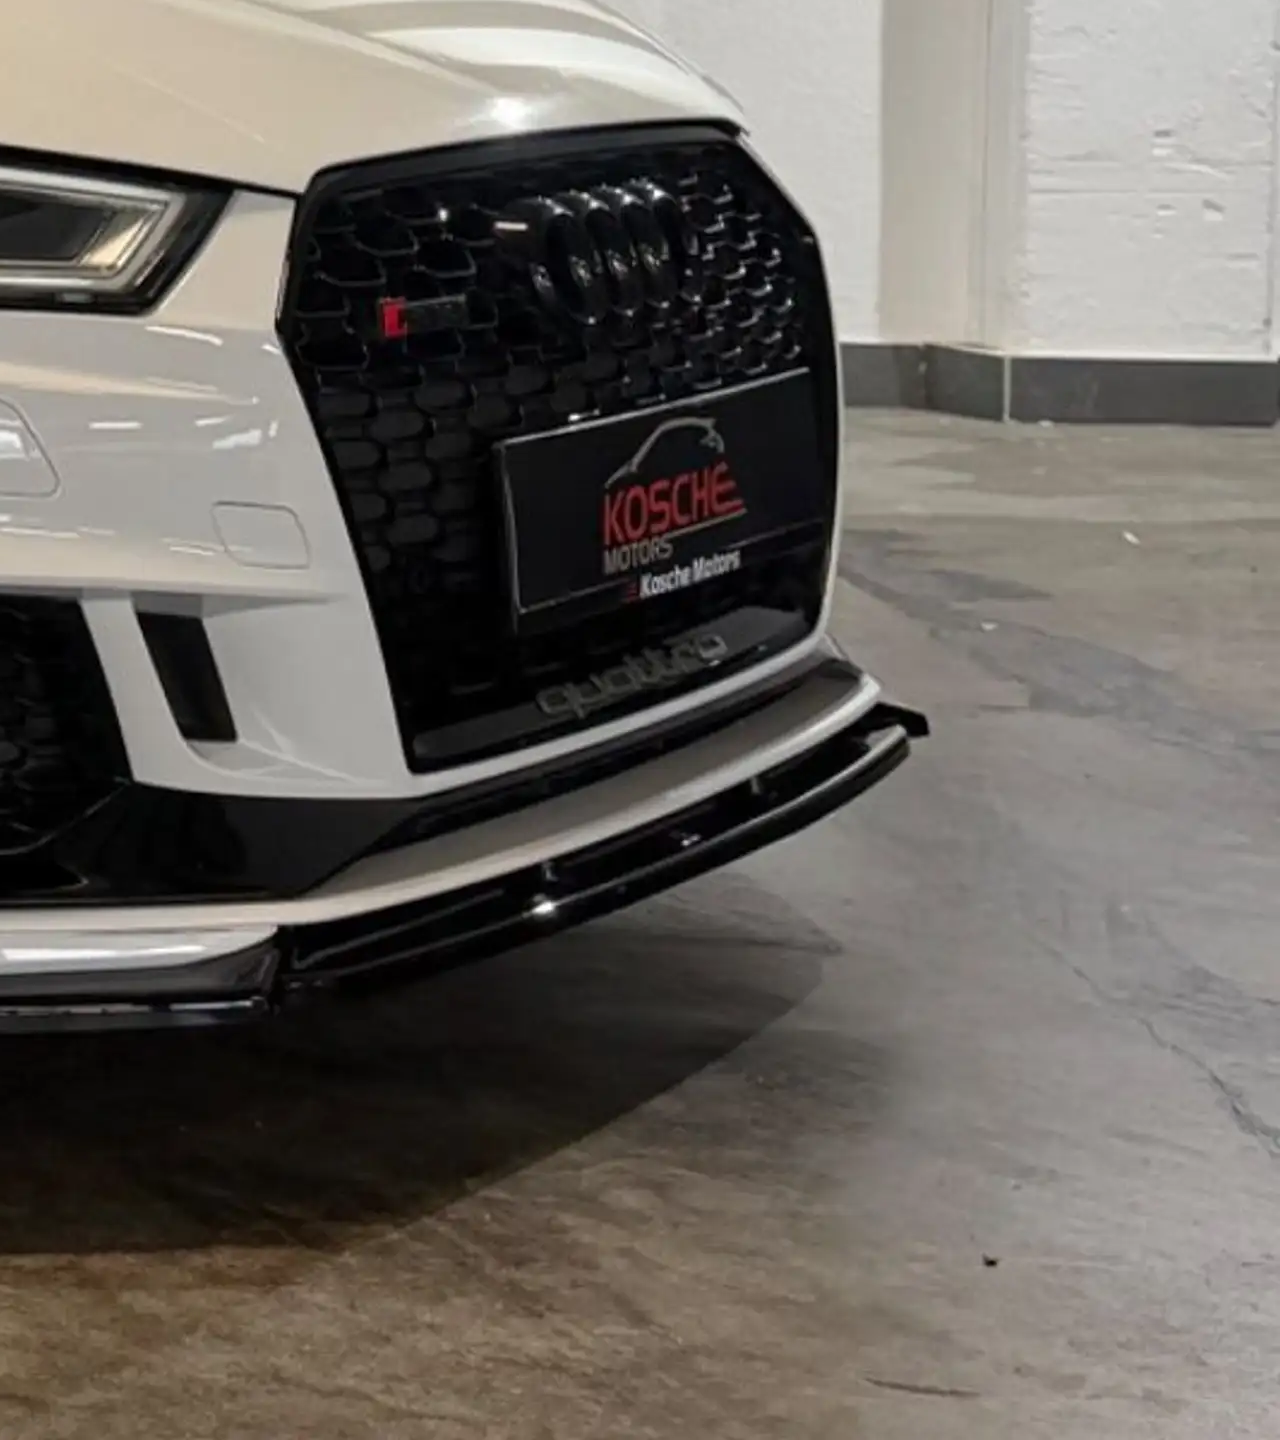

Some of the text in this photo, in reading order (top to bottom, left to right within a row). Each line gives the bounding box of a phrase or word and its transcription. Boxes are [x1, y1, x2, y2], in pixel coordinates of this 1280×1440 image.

[602, 460, 744, 546] KOSCHE
[603, 536, 674, 574] MOTORS
[640, 550, 741, 600] Kosche Motors
[536, 634, 728, 720] quattro
